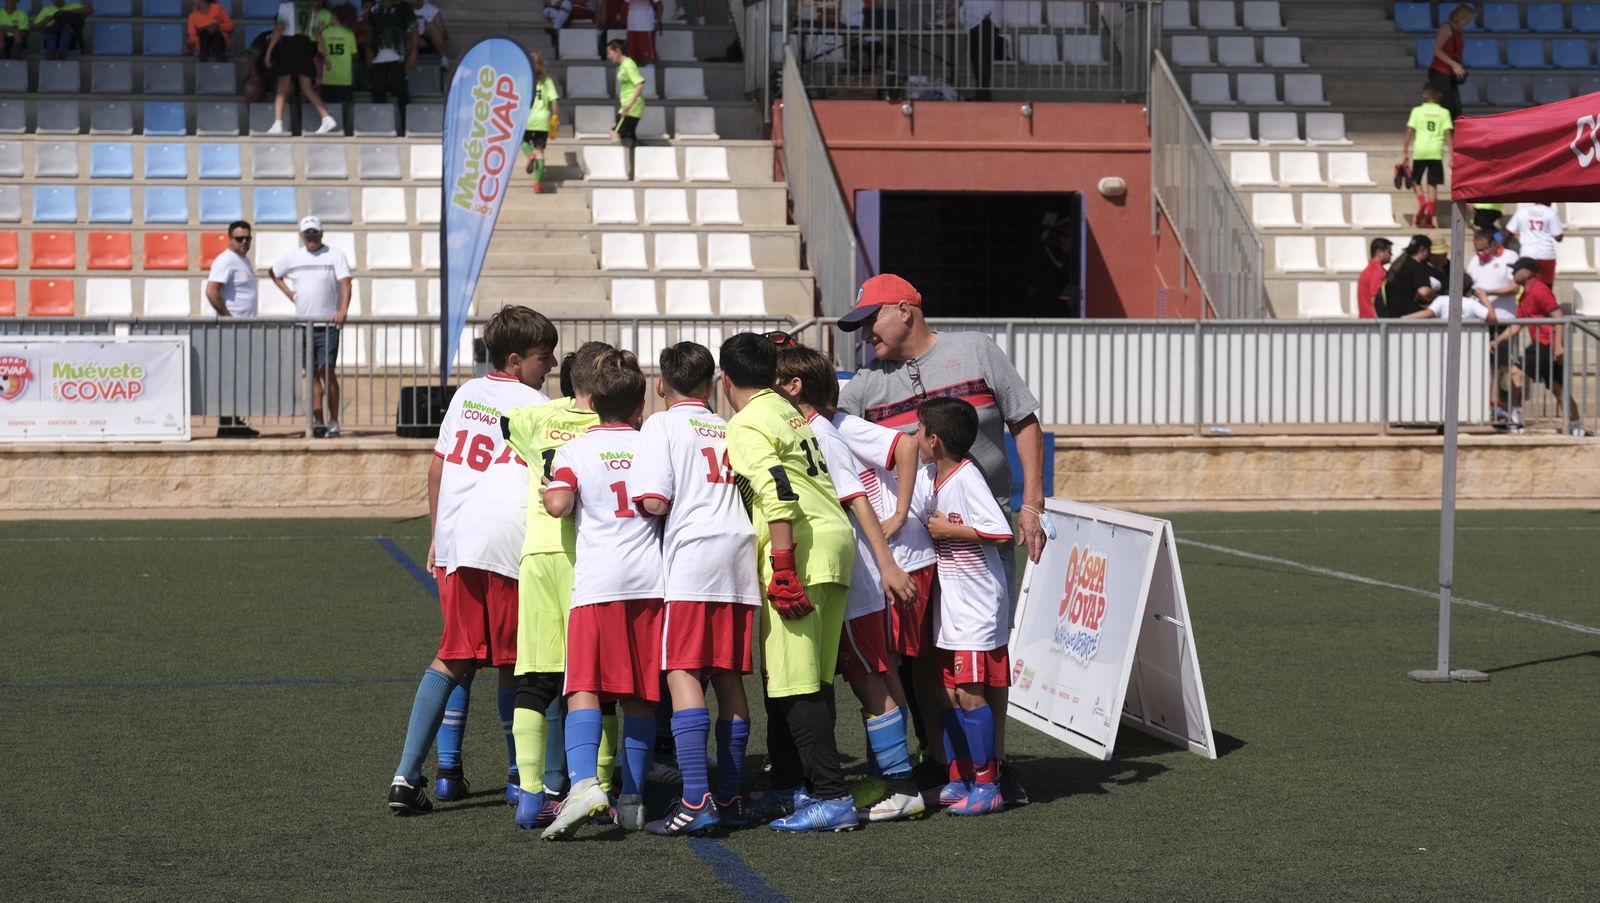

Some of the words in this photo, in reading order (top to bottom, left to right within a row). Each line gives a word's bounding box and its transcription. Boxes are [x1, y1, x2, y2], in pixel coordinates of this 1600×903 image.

[327, 43, 345, 55] 15
[1427, 121, 1436, 132] 8
[452, 66, 496, 210] Muévete
[478, 75, 520, 203] COVAP
[1528, 219, 1544, 231] 17
[0, 365, 26, 375] OVAP
[52, 361, 144, 379] Muévete
[61, 381, 142, 400] COVAP
[462, 399, 502, 417] Muévete
[464, 409, 497, 425] COVAP
[549, 429, 575, 441] CO
[446, 429, 495, 472] 16
[609, 459, 633, 469] CO
[1077, 548, 1106, 593] COPA
